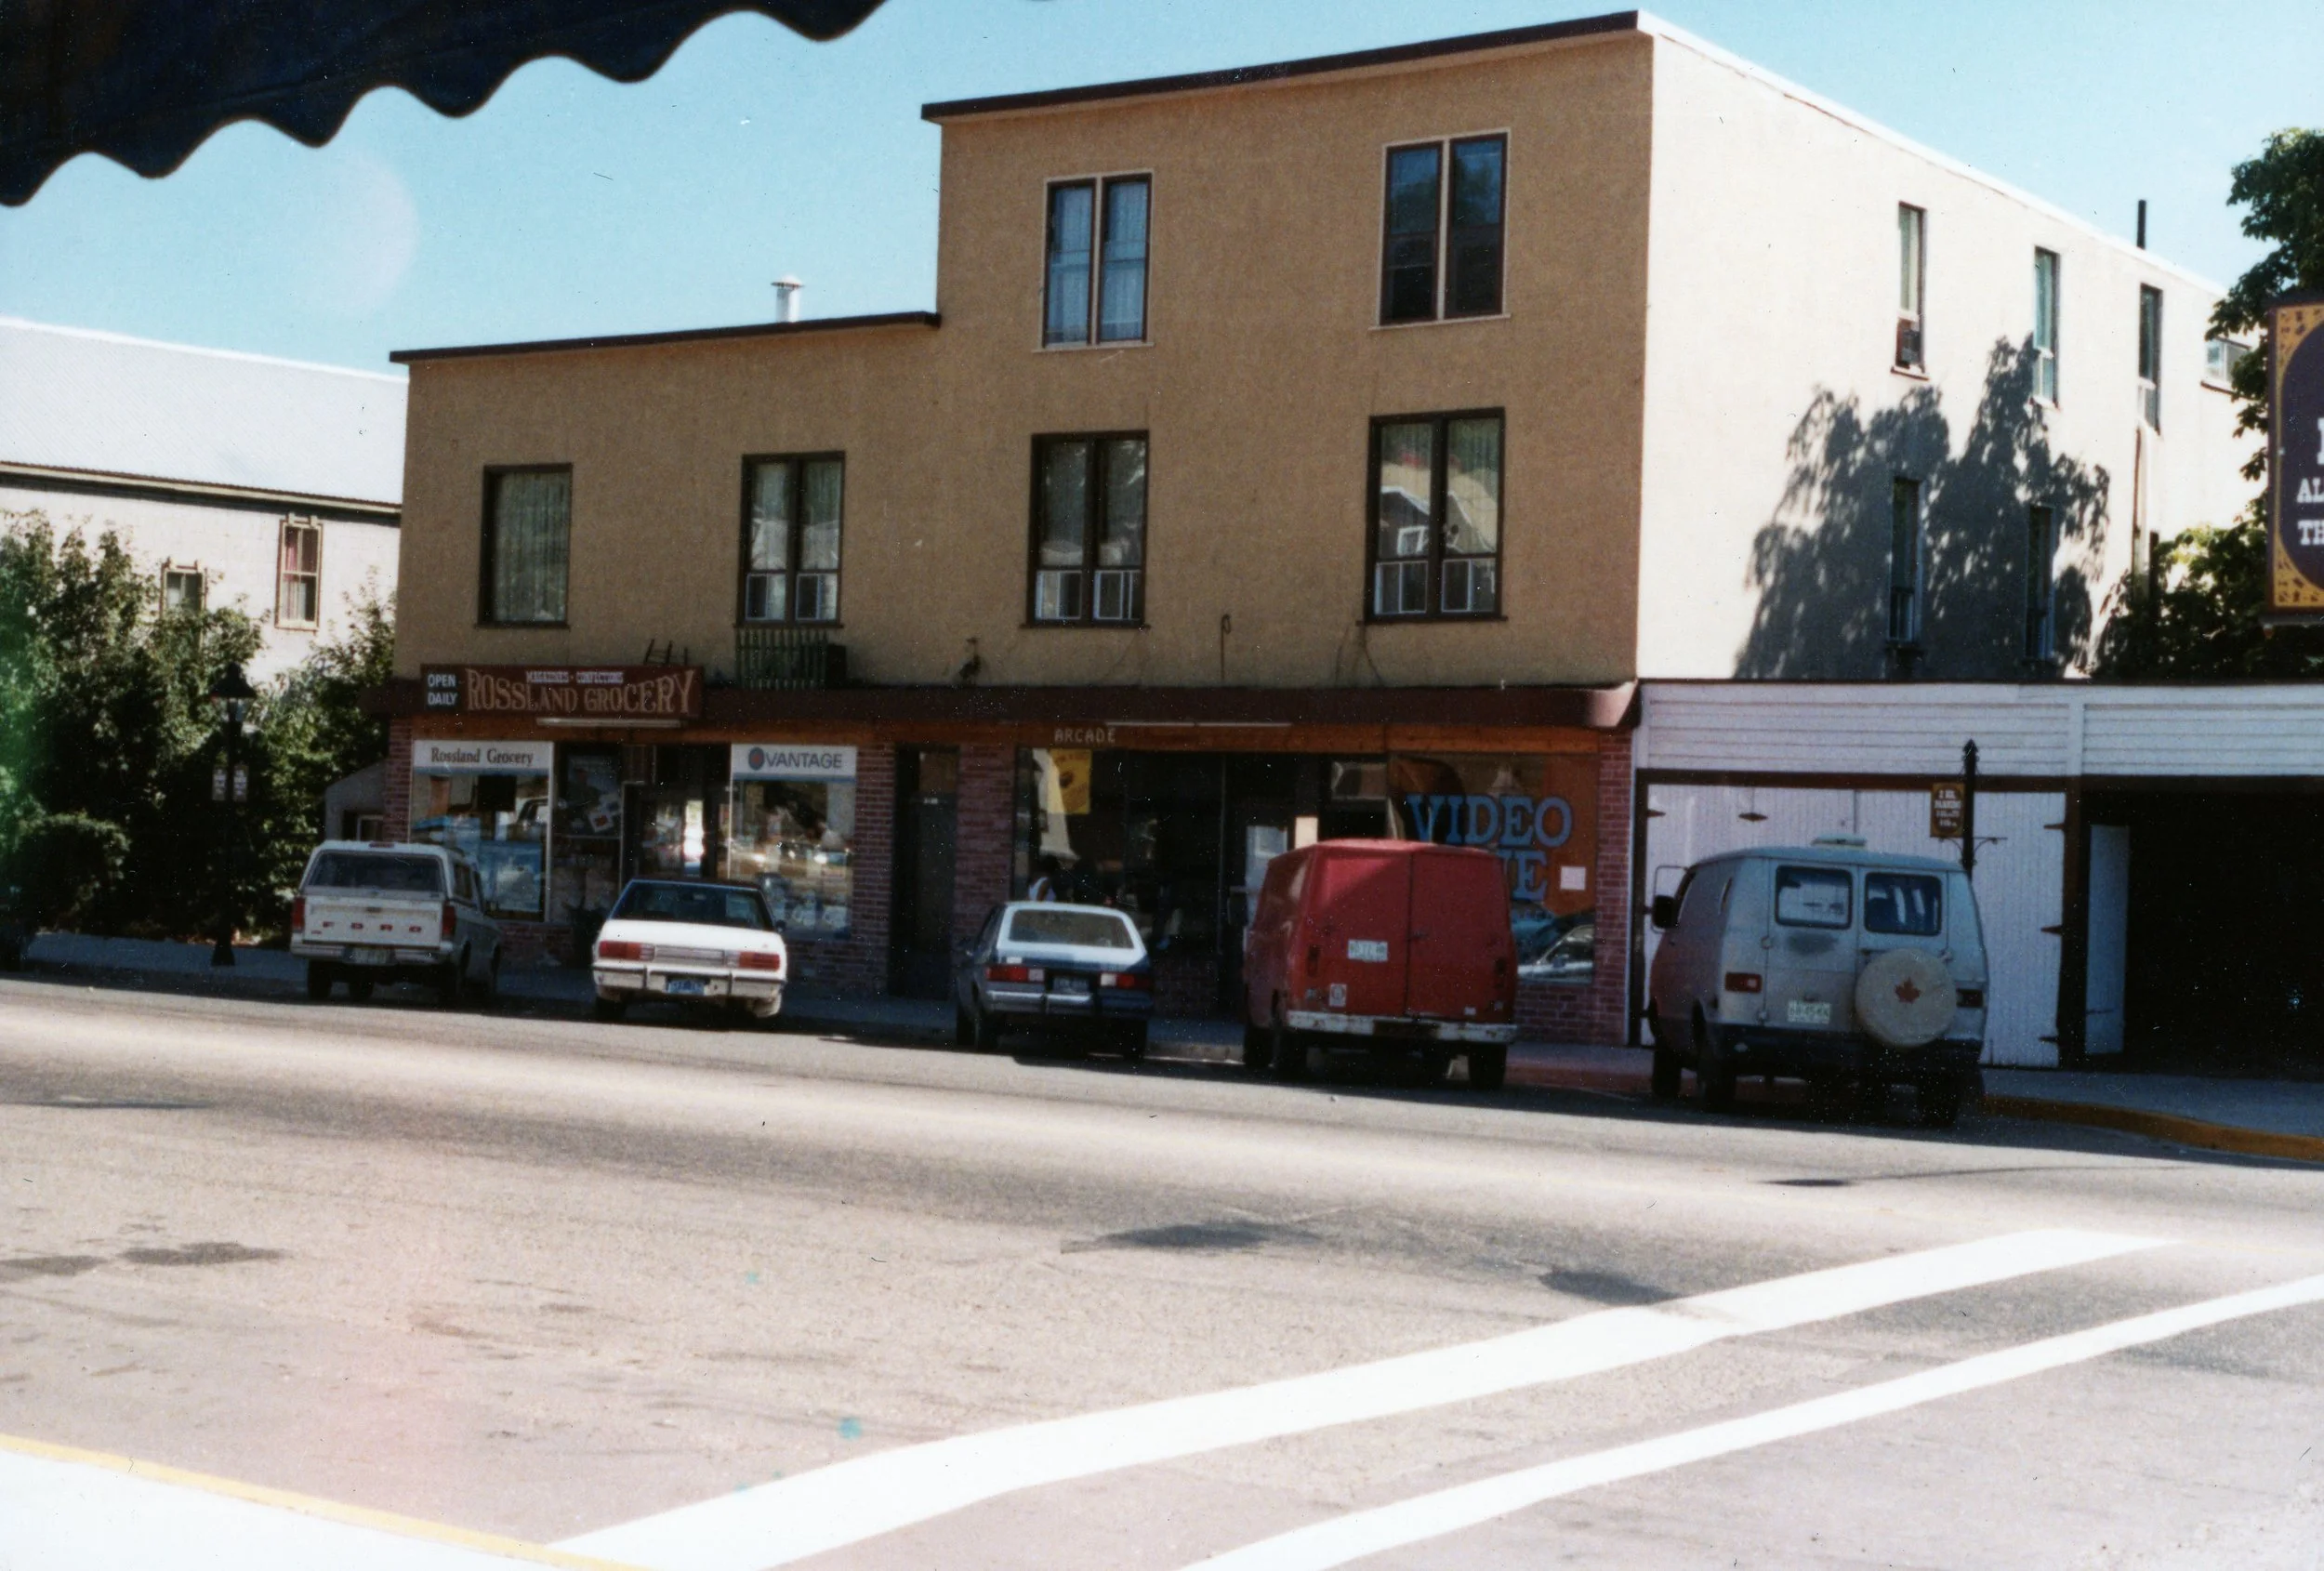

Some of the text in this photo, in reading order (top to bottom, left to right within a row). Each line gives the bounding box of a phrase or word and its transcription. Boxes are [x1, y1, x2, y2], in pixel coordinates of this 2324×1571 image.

[427, 673, 456, 687] OPEN
[427, 691, 458, 706] DAILY
[465, 667, 695, 713] ROSSLAND GROCERY
[1054, 727, 1116, 744] ARCADE
[430, 746, 535, 767] Rossland Grocery
[765, 751, 843, 770] VANTAGE
[1405, 794, 1573, 848] VIDEO
